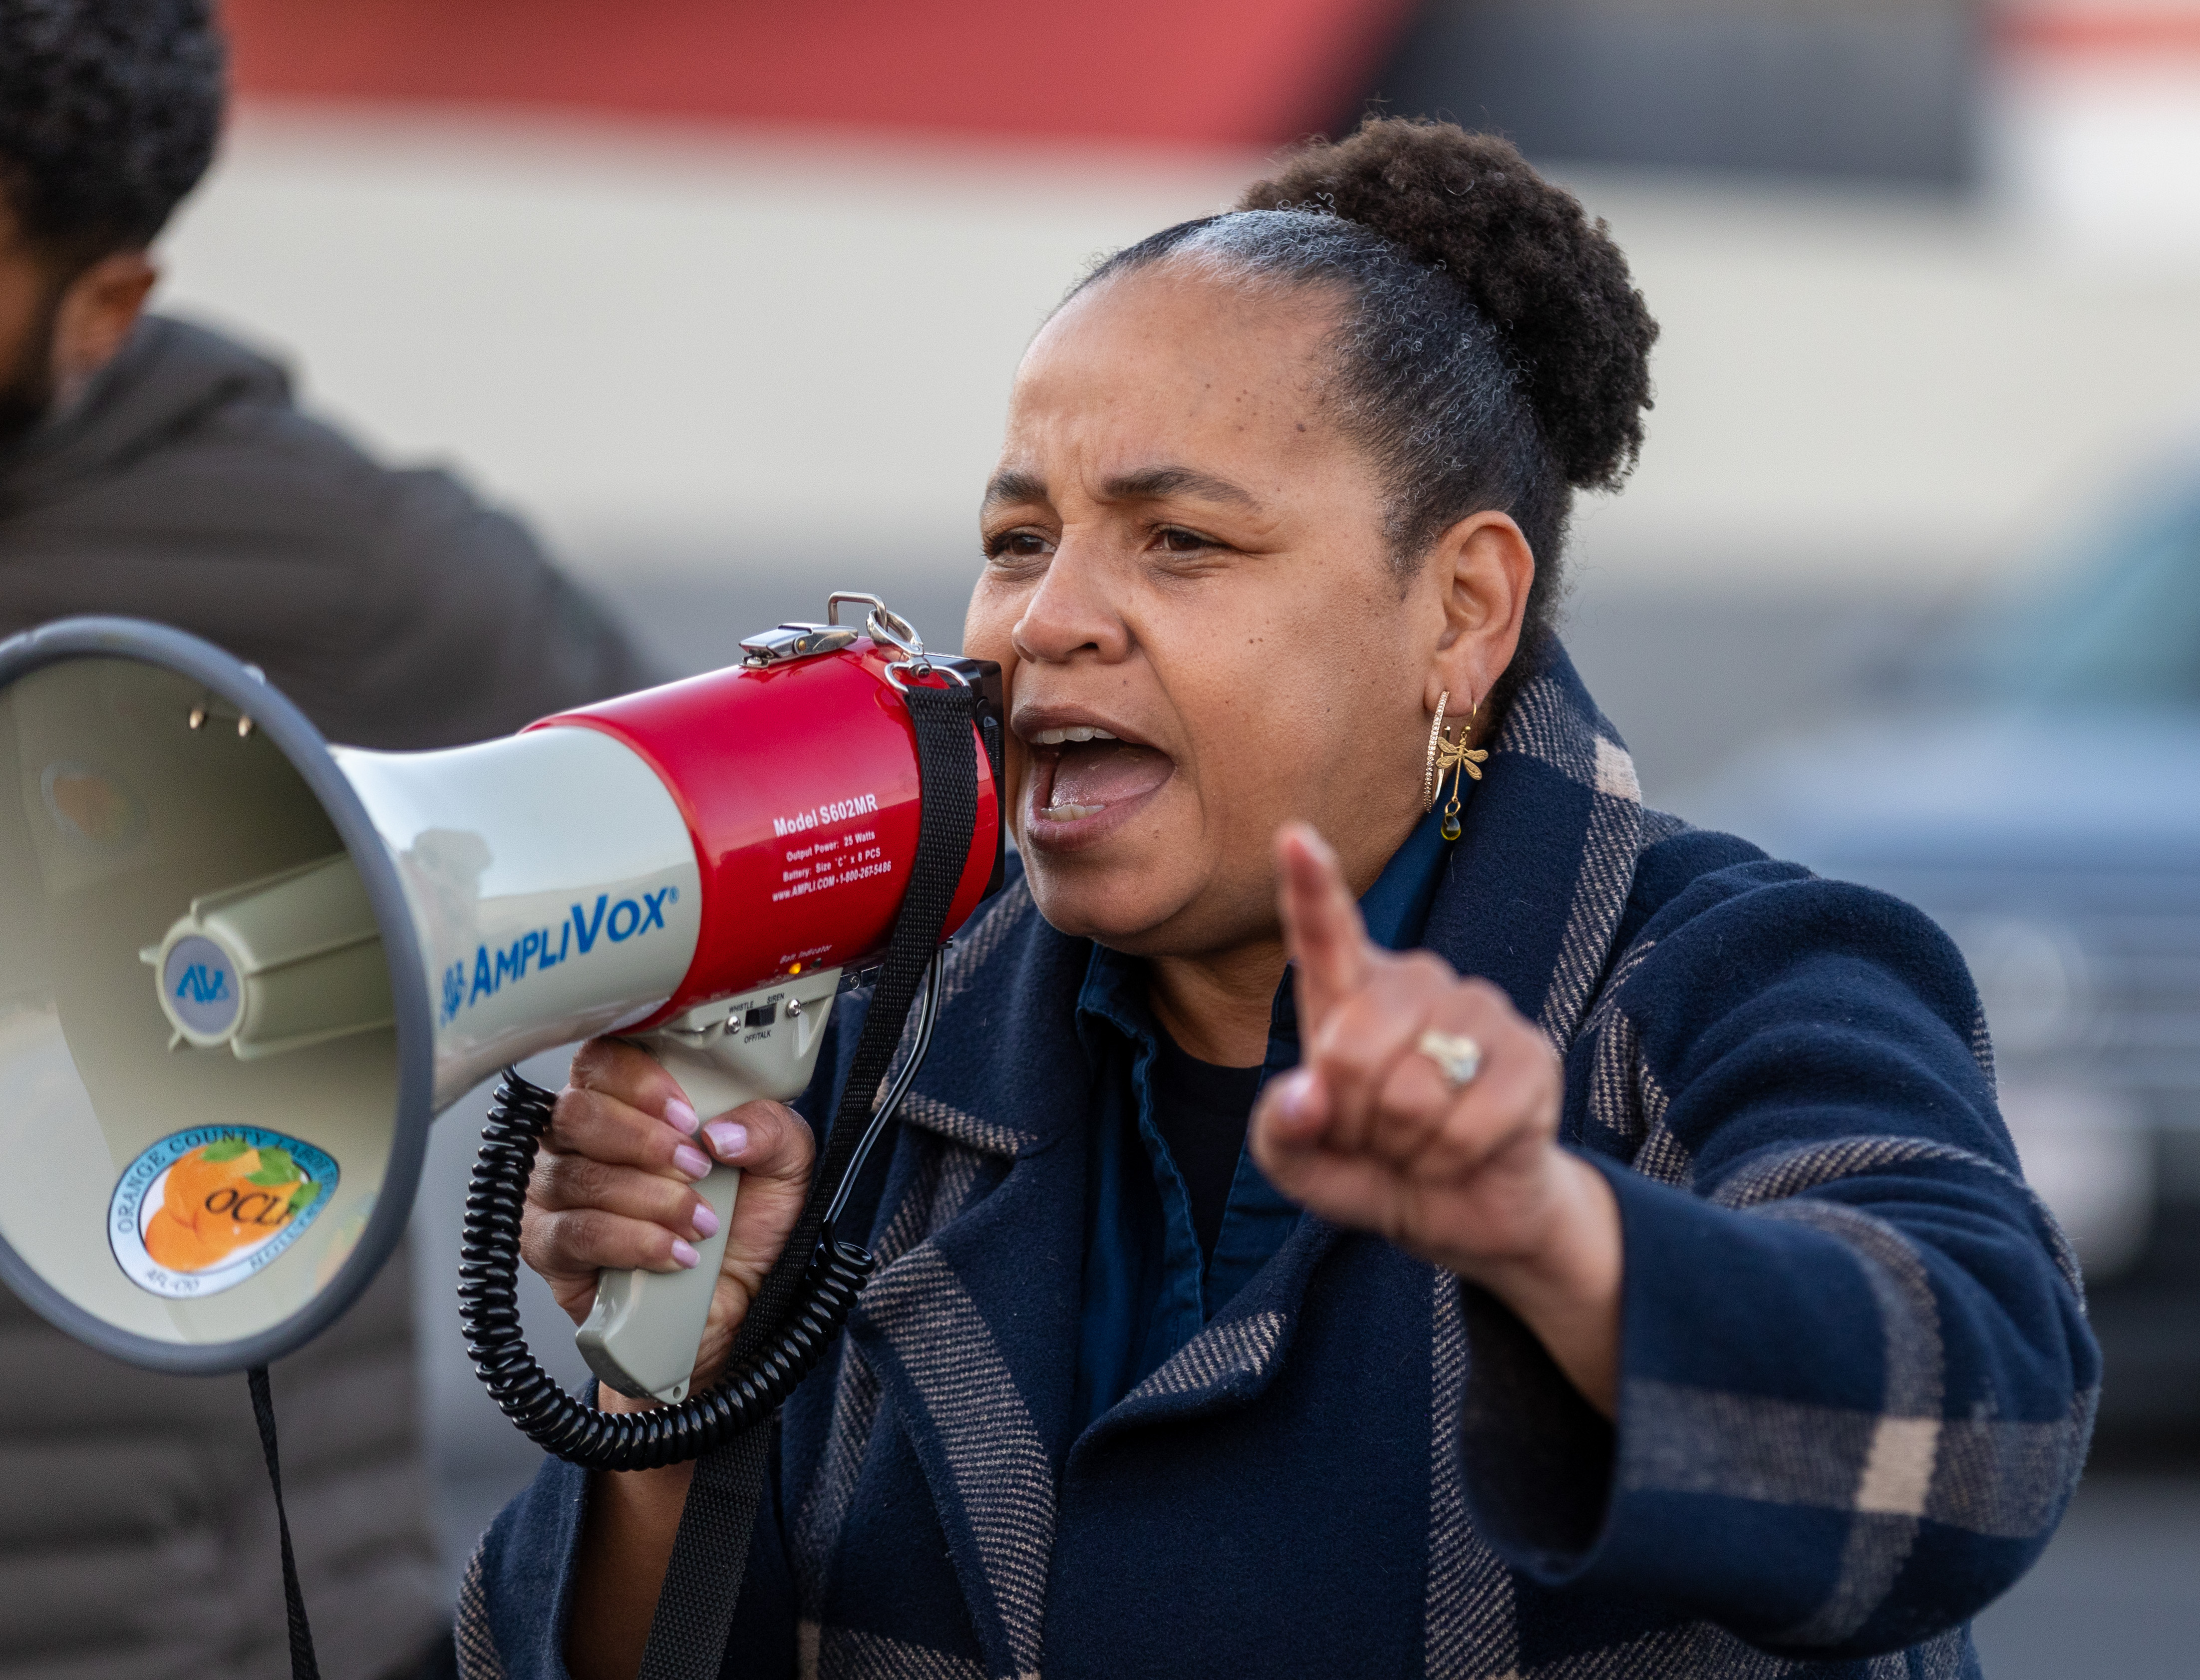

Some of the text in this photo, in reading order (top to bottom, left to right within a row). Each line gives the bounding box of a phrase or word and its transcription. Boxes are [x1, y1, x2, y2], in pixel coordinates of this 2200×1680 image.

[773, 793, 878, 837] Model S602MR
[786, 846, 813, 862] Output
[844, 835, 854, 847] 25
[855, 831, 876, 844] Watts
[815, 862, 832, 874] Size
[858, 852, 863, 862] 8
[865, 847, 881, 860] PCS
[729, 1000, 754, 1013] WHISTLE
[767, 992, 785, 1005] SIREN
[744, 1029, 771, 1044] OFF/TALK
